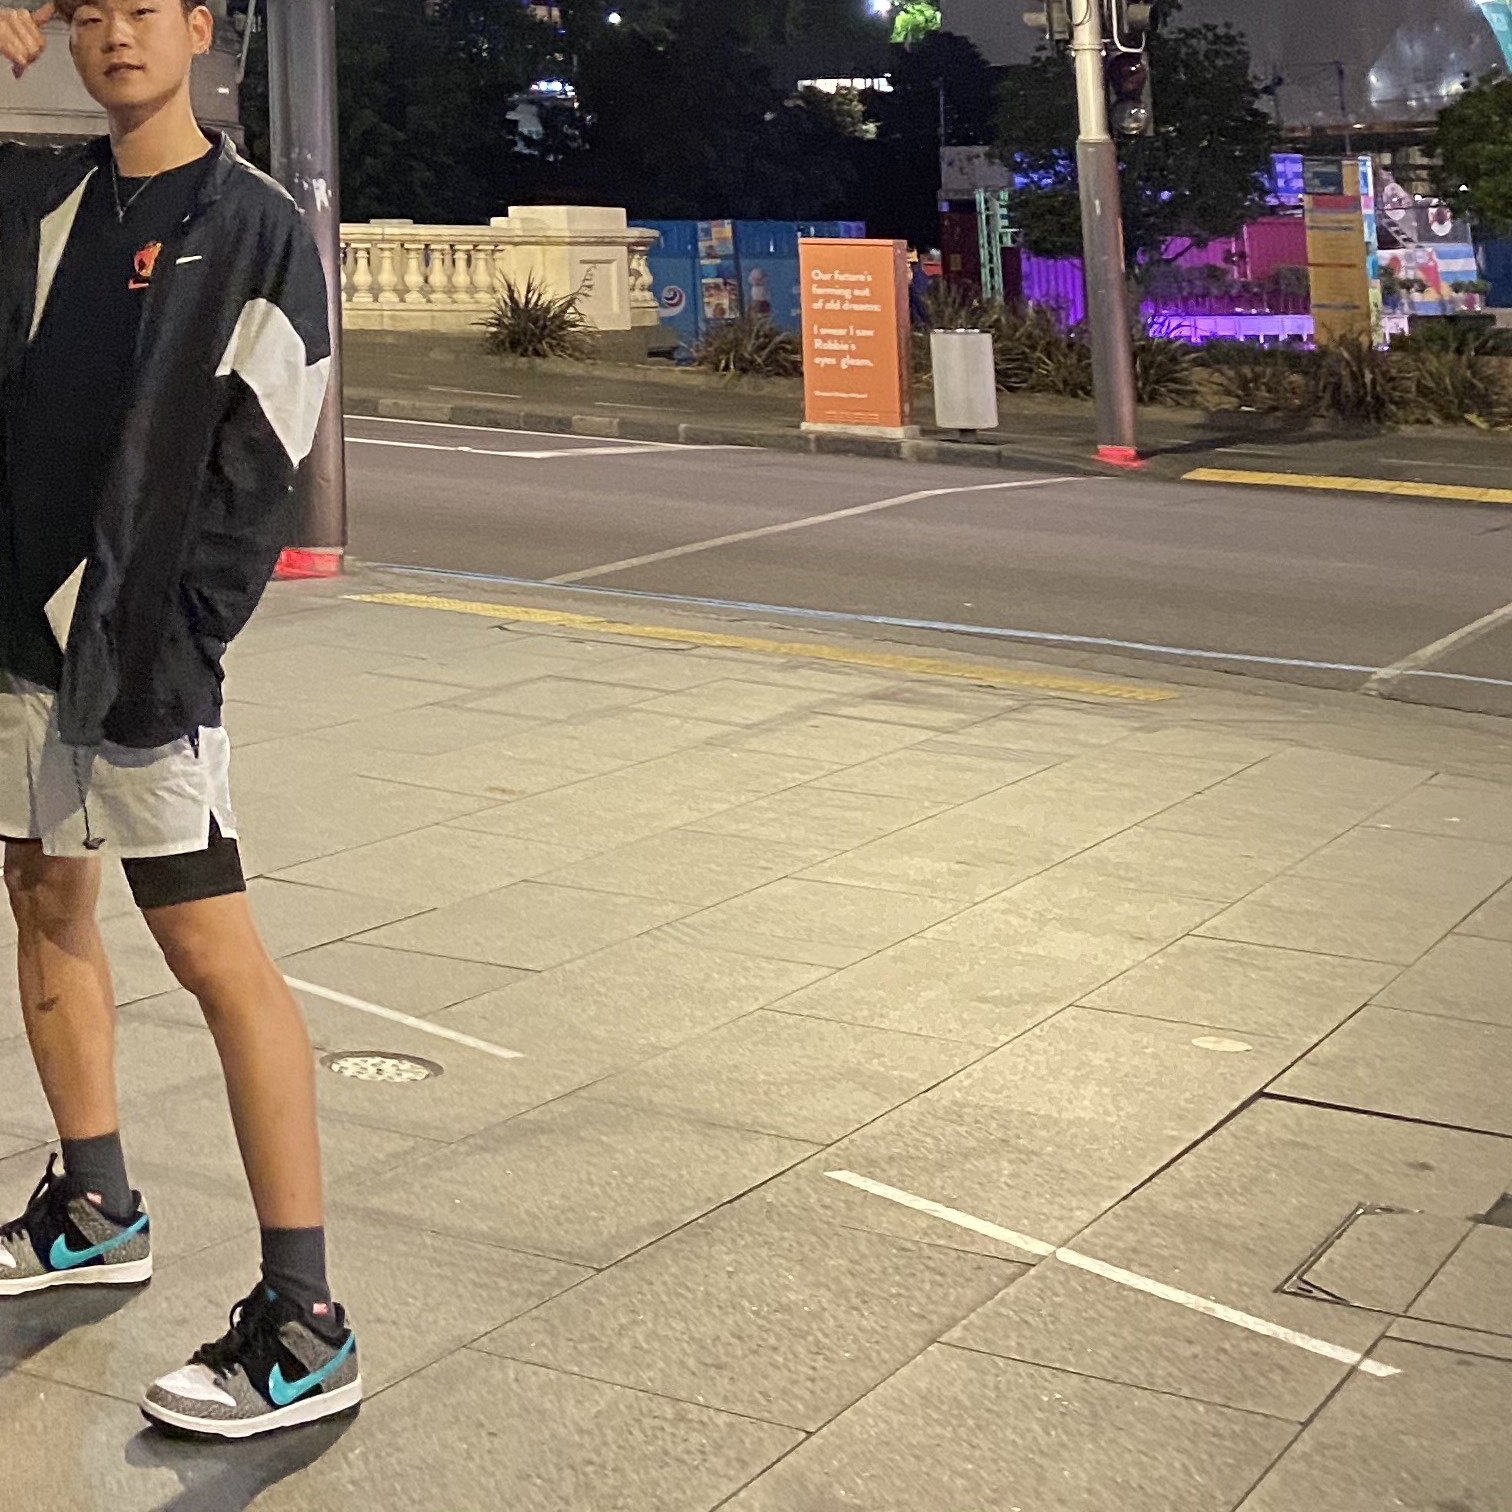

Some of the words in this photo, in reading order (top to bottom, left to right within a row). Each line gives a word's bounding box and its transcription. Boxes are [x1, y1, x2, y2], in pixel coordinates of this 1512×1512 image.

[811, 269, 831, 280] Our
[833, 270, 872, 281] future's
[812, 284, 852, 299] forming
[853, 288, 871, 296] out
[812, 299, 824, 309] of
[825, 299, 841, 310] old
[813, 324, 818, 335] I
[849, 325, 854, 336] I
[813, 357, 837, 367] eyes
